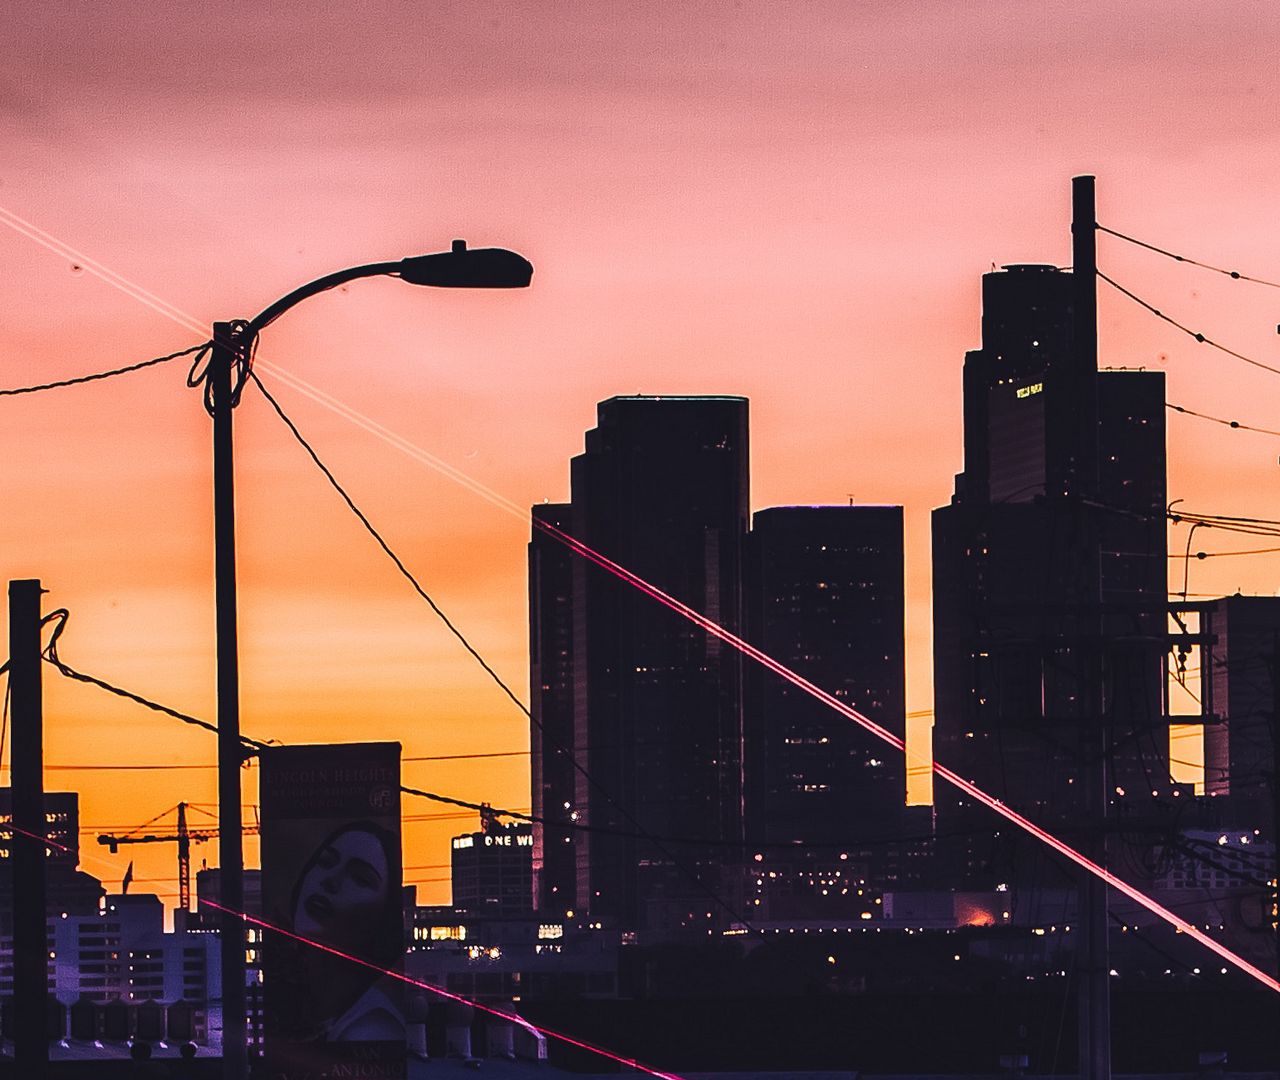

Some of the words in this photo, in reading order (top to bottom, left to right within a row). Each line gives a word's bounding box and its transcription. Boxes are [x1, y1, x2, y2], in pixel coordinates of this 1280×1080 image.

[266, 768, 329, 784] LINCOLN
[334, 767, 395, 783] HEIGHTS
[484, 835, 512, 846] ONE
[330, 1063, 403, 1077] ANTONIO
